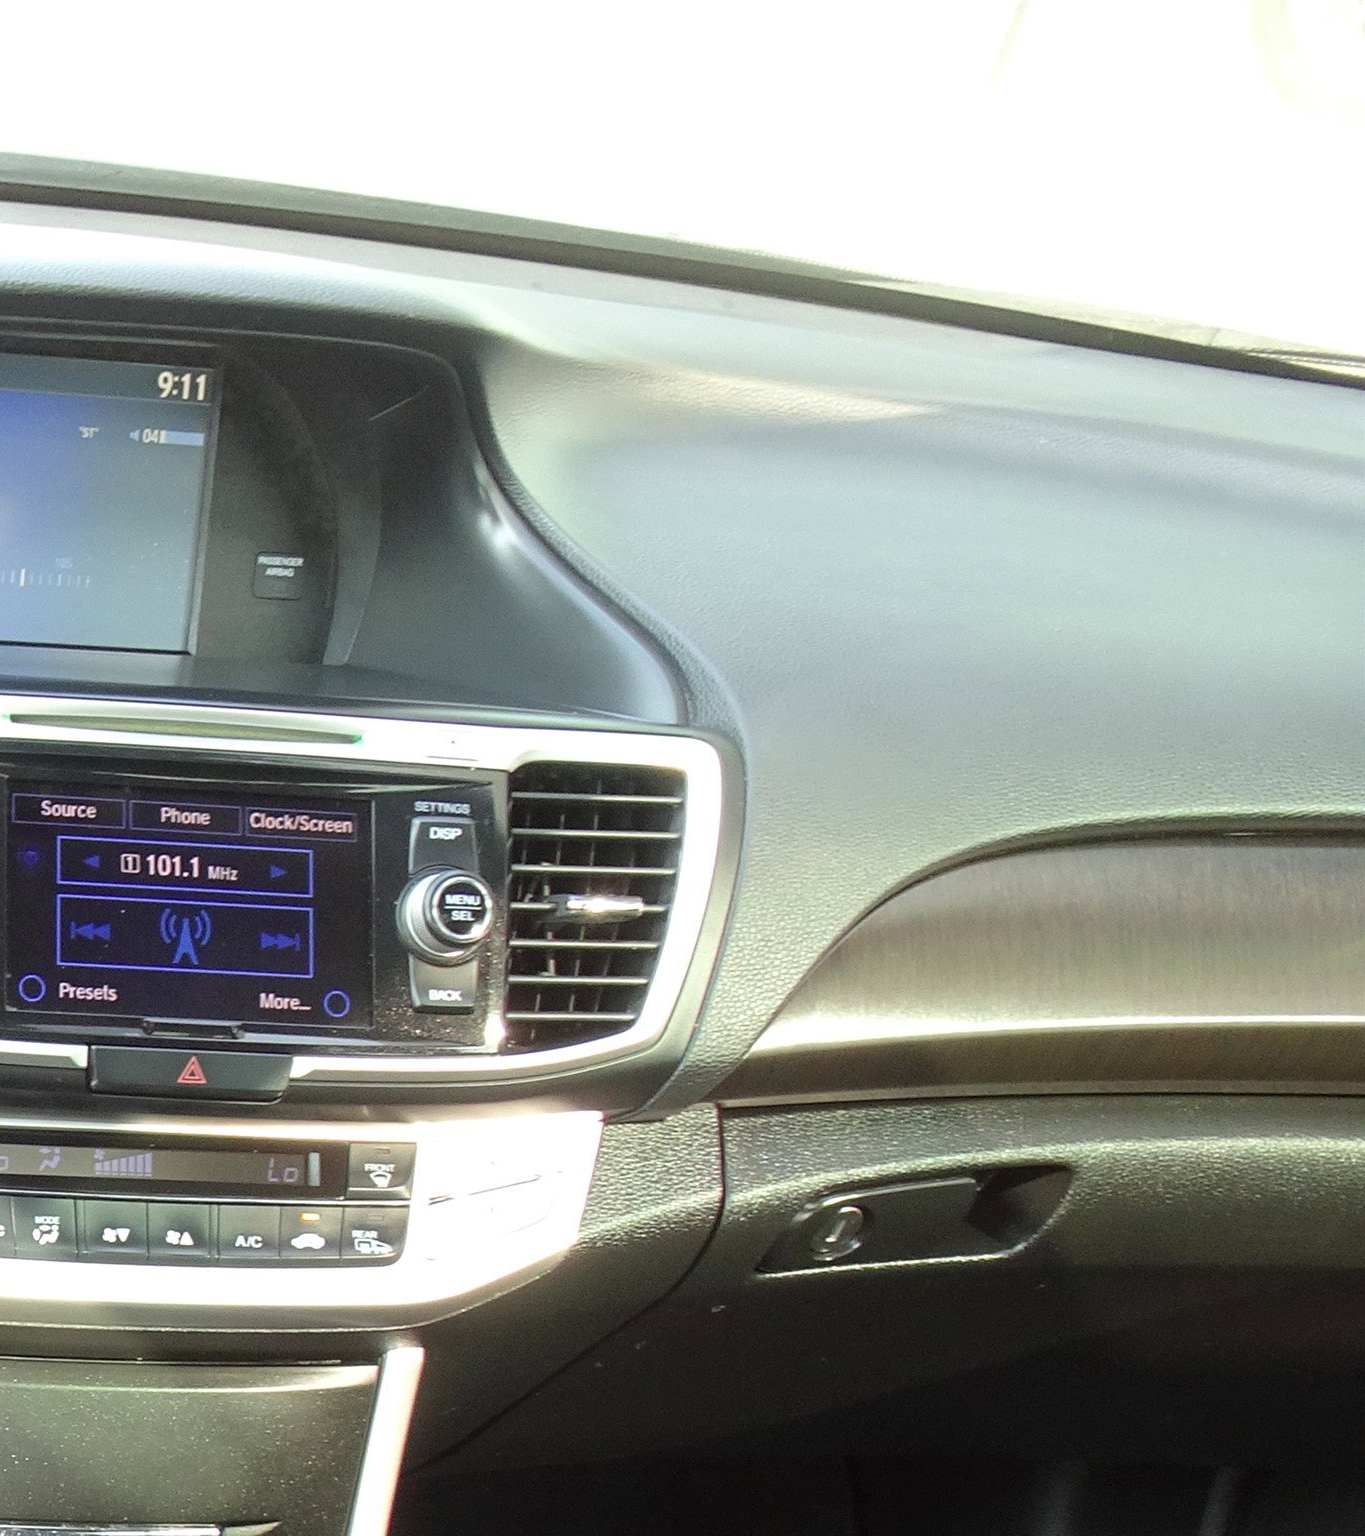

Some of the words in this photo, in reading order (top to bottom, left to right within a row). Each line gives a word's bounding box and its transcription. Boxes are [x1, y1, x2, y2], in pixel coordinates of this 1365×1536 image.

[157, 370, 207, 401] 9:11
[40, 799, 98, 819] Source
[413, 800, 471, 815] SETTINGS
[159, 806, 212, 826] Phone
[248, 811, 354, 835] Clock/Screen
[428, 826, 463, 841] DISP
[145, 853, 201, 878] 101.1
[207, 864, 240, 881] MHz
[444, 893, 482, 907] MENU
[450, 909, 476, 923] SEL
[58, 981, 119, 1002] Presets
[427, 988, 463, 1002] BACK
[363, 1163, 396, 1173] FRONT
[34, 1215, 61, 1226] MODE
[234, 1235, 264, 1249] A/C
[351, 1229, 378, 1240] REAR
